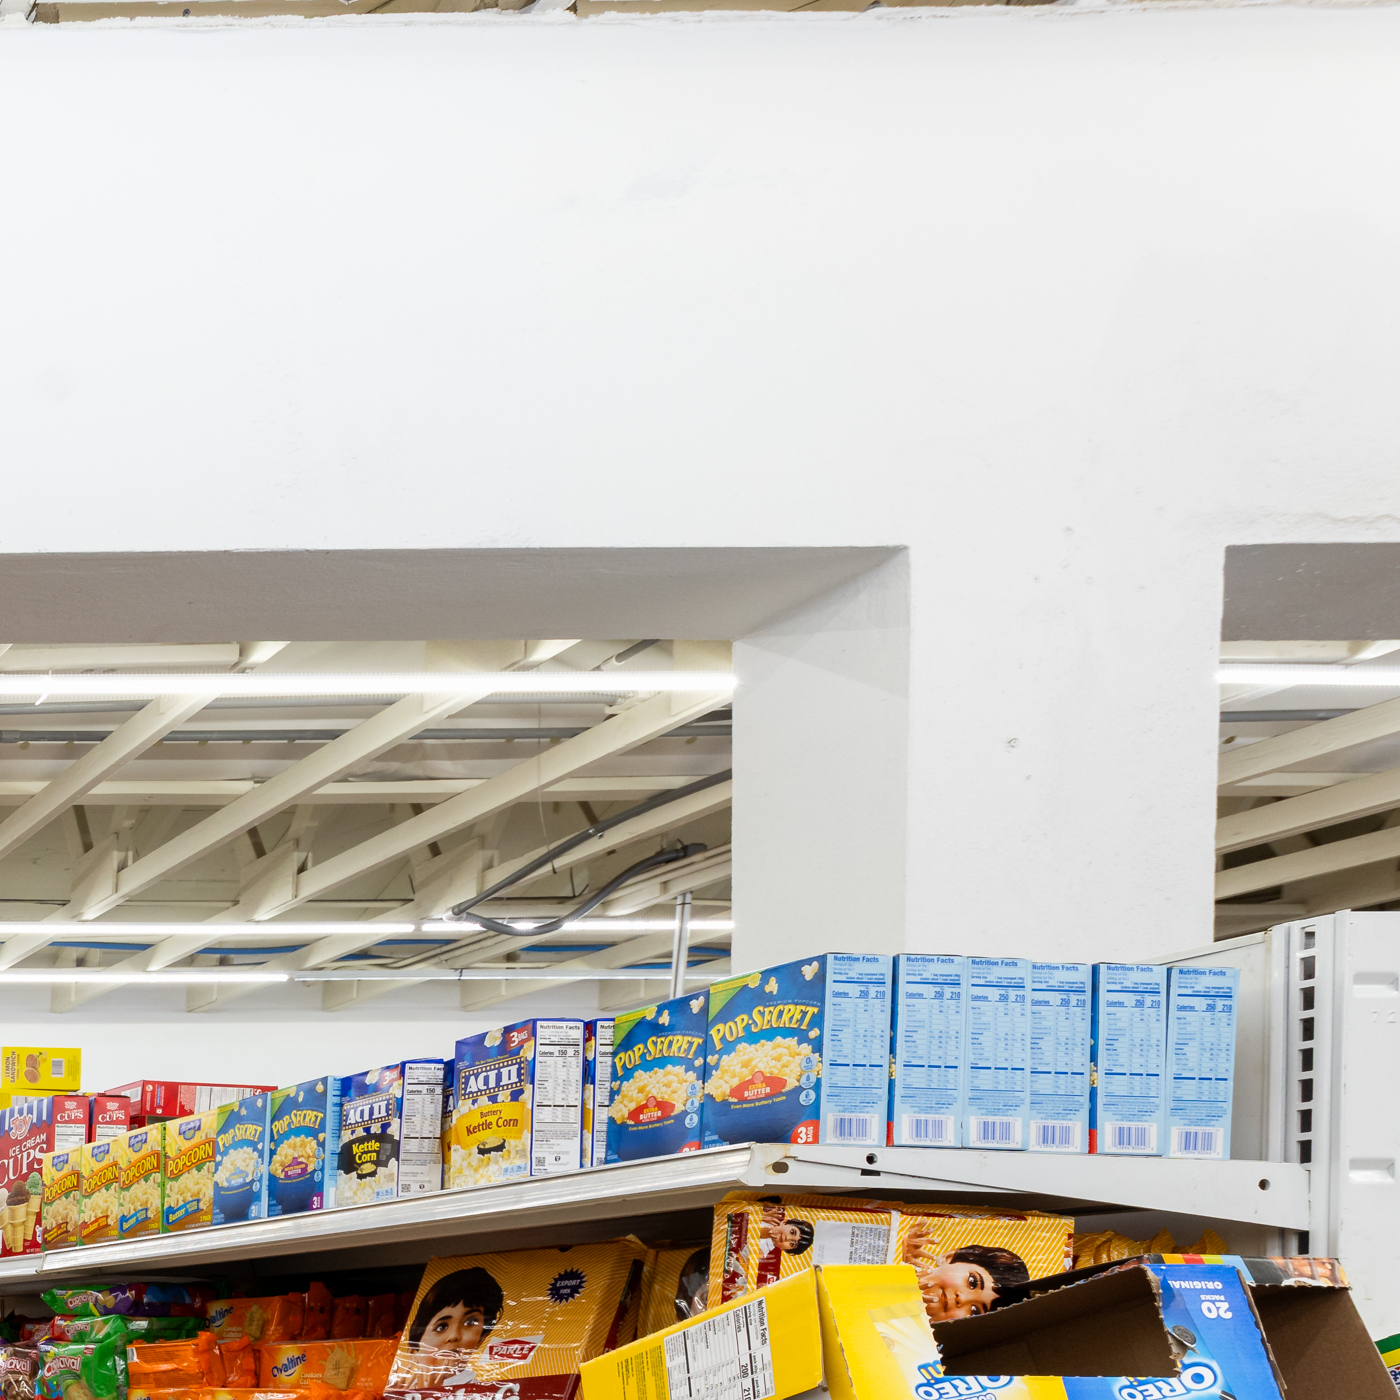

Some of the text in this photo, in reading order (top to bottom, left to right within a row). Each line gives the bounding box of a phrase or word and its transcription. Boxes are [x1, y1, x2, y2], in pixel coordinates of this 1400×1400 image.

[466, 1070, 497, 1094] ACT
[749, 1083, 766, 1091] EXTRA
[743, 1087, 771, 1098] BUTTER
[479, 1108, 503, 1119] Buttery
[465, 1116, 519, 1137] Kettle Corn
[167, 1142, 214, 1176] POPCORN
[492, 1344, 531, 1356] PARLE
